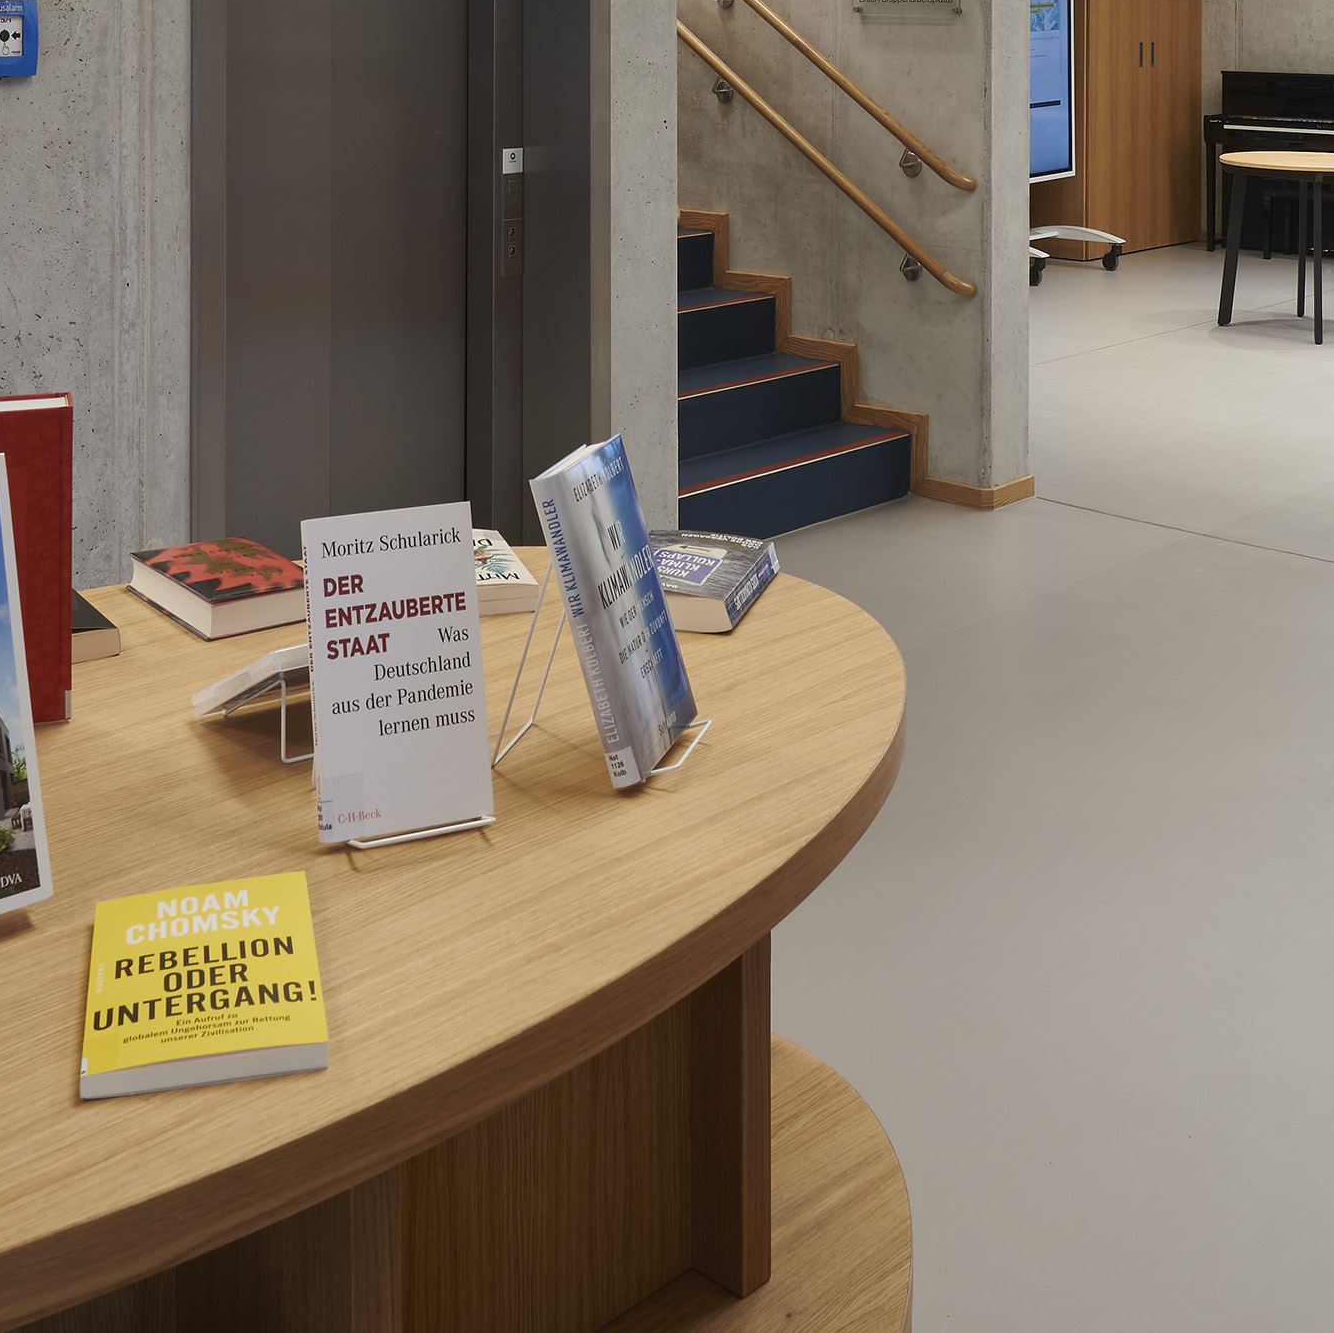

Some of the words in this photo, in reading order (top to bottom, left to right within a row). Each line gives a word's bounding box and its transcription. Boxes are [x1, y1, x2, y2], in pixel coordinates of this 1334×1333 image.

[573, 473, 603, 502] ELIZABETH
[321, 538, 375, 558] Moritz
[379, 527, 461, 552] Schularick
[542, 499, 579, 592] KLIMAWANDLER
[608, 520, 627, 551] WIR
[657, 559, 701, 572] KLIMA-
[657, 566, 689, 578] KURS
[659, 551, 715, 566] KOLLAPS
[323, 574, 364, 597] DER
[305, 580, 313, 650] ENTZAUBERTE
[325, 592, 467, 628] ENTZAUBERTE
[569, 594, 585, 618] WIR
[629, 605, 638, 622] DER
[327, 632, 390, 660] STAAT
[438, 626, 469, 644] Was
[575, 623, 601, 675] KOLBERT
[374, 652, 471, 681] Deutschland
[332, 698, 361, 715] aus
[365, 692, 392, 710] der
[397, 680, 474, 706] Pandemie
[592, 678, 619, 744] ELIZABETH
[379, 716, 431, 736] lernen
[435, 709, 475, 728] muss
[613, 769, 627, 777] Kolb
[0, 872, 23, 889] DVA
[157, 890, 249, 919] NOAM
[125, 906, 279, 945] CHOMSKY
[115, 936, 294, 980] REBELLION
[163, 963, 249, 992] ODER
[93, 980, 317, 1031] UNTERGANG!
[176, 1018, 191, 1026] Ein
[193, 1014, 225, 1024] Aufruf
[123, 1030, 168, 1044] globalem
[171, 1022, 231, 1034] Ungehorsam
[235, 1018, 249, 1026] zur
[252, 1014, 291, 1025] Rettung
[161, 1033, 199, 1043] unserer
[201, 1025, 255, 1038] Zivilisation
